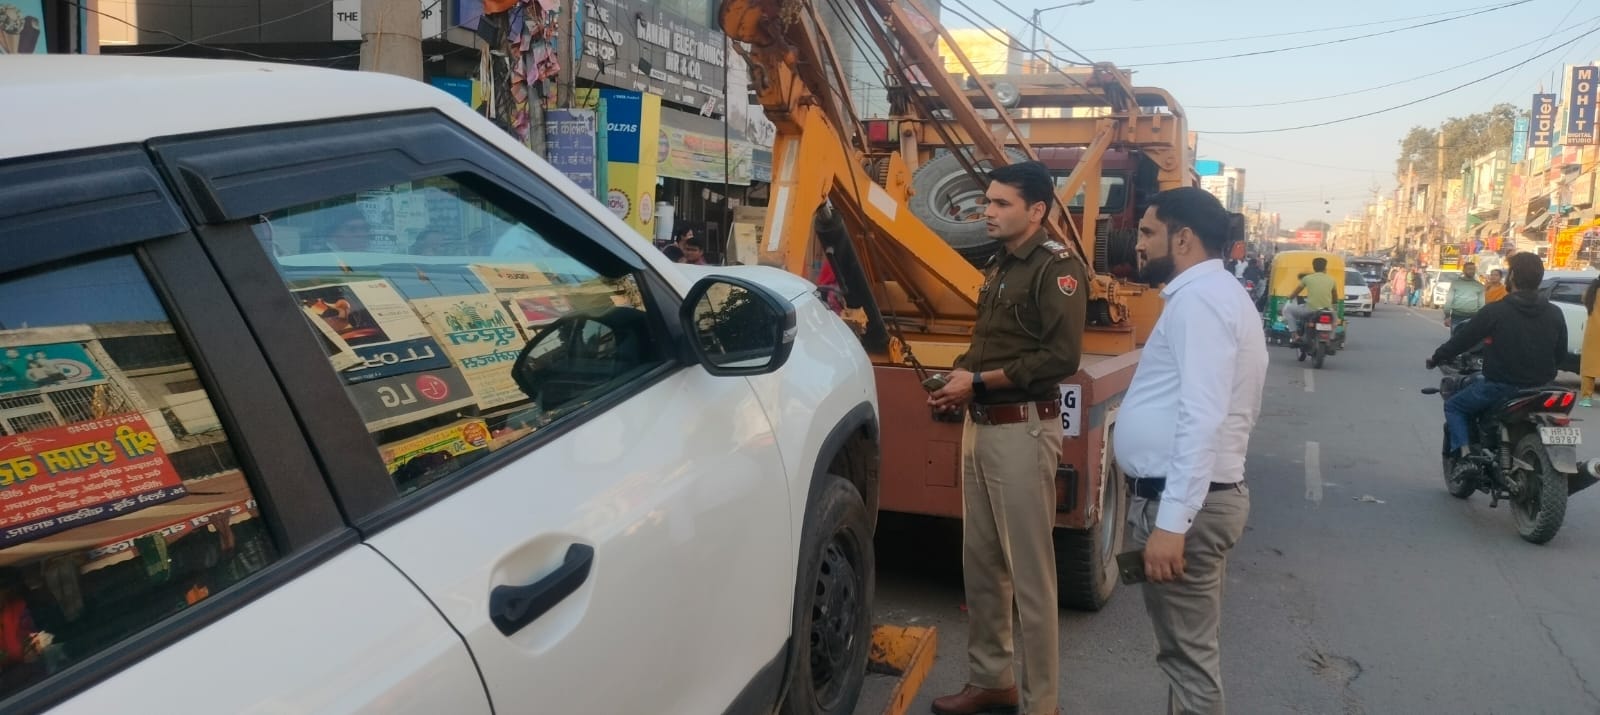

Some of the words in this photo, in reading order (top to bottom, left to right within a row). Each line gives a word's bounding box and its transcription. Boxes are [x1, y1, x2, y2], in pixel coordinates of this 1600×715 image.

[336, 12, 358, 21] THE
[585, 22, 623, 46] BRAND
[584, 41, 615, 61] SHOP
[1576, 69, 1592, 131] MOHIT
[607, 123, 638, 133] OLTAS
[1534, 98, 1552, 145] Haier
